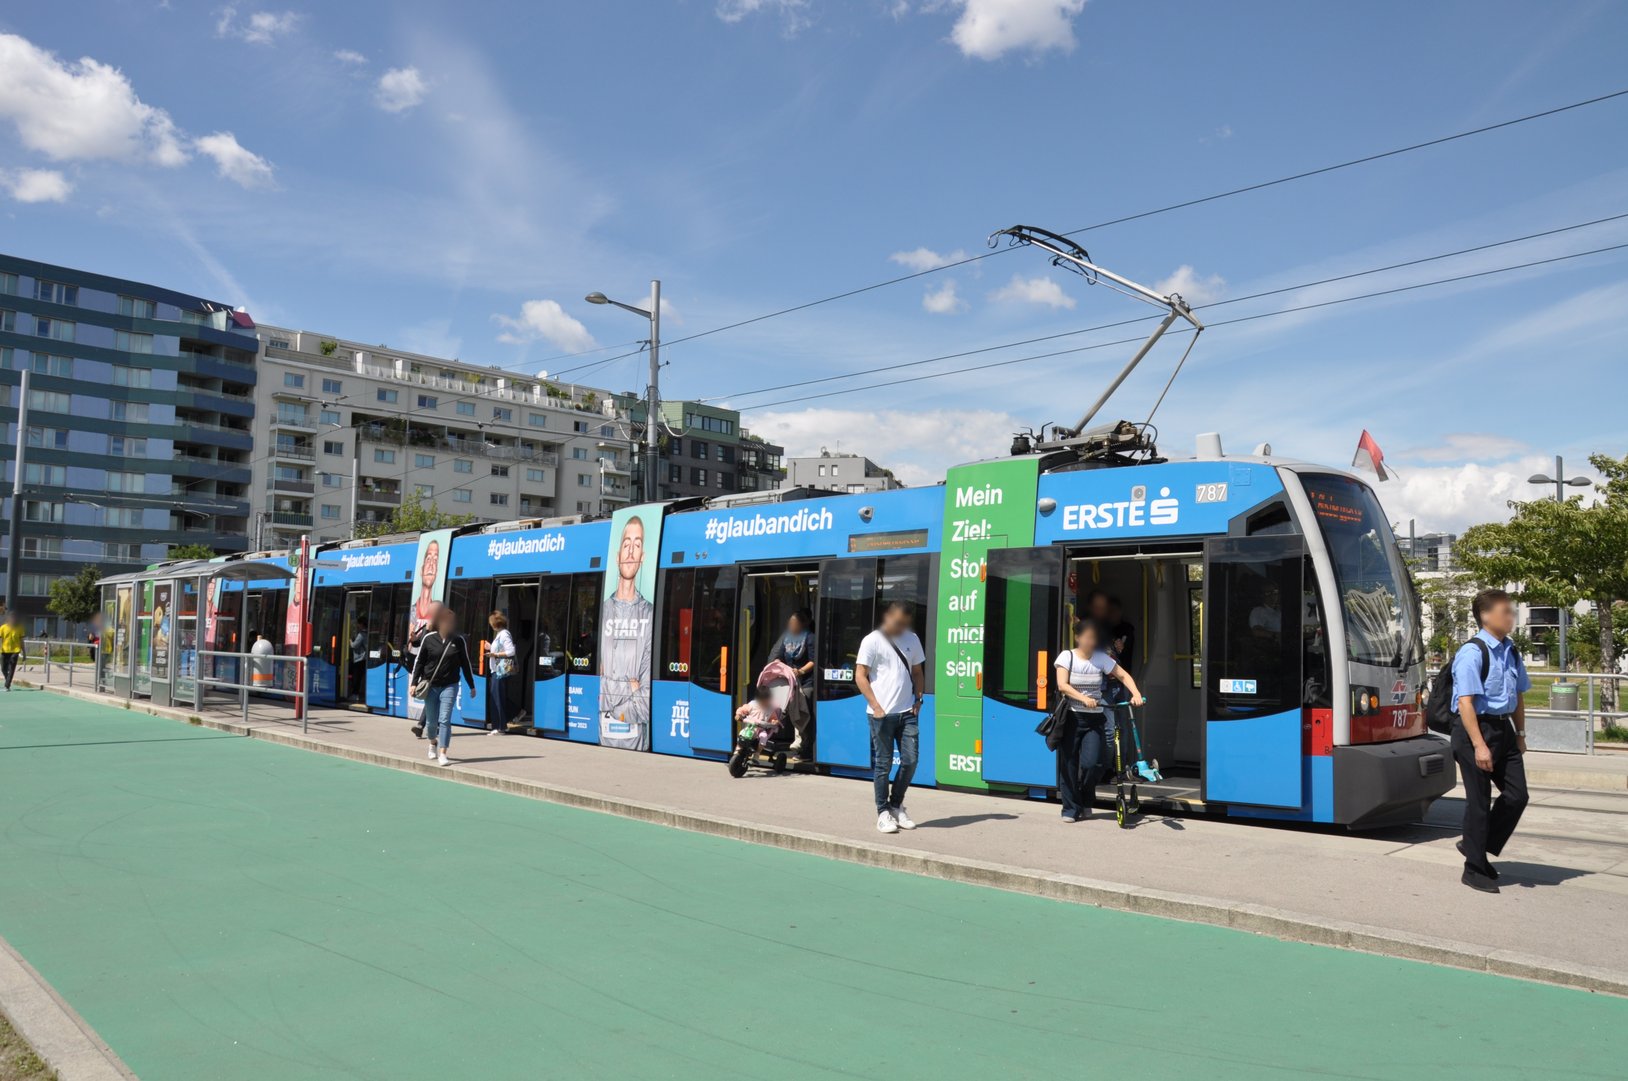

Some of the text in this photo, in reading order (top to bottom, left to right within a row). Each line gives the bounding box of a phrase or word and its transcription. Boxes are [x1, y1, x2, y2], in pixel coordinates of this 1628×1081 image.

[955, 483, 1003, 508] Mein
[1197, 484, 1228, 502] 787
[705, 507, 833, 544] #glaubandich
[1063, 501, 1146, 530] ERSTE
[952, 519, 992, 542] Ziel:
[487, 533, 566, 560] #glaubandich
[948, 590, 978, 611] auf
[604, 619, 649, 637] START
[946, 656, 983, 677] sein
[1392, 709, 1408, 727] 787
[949, 753, 983, 773] ERST
